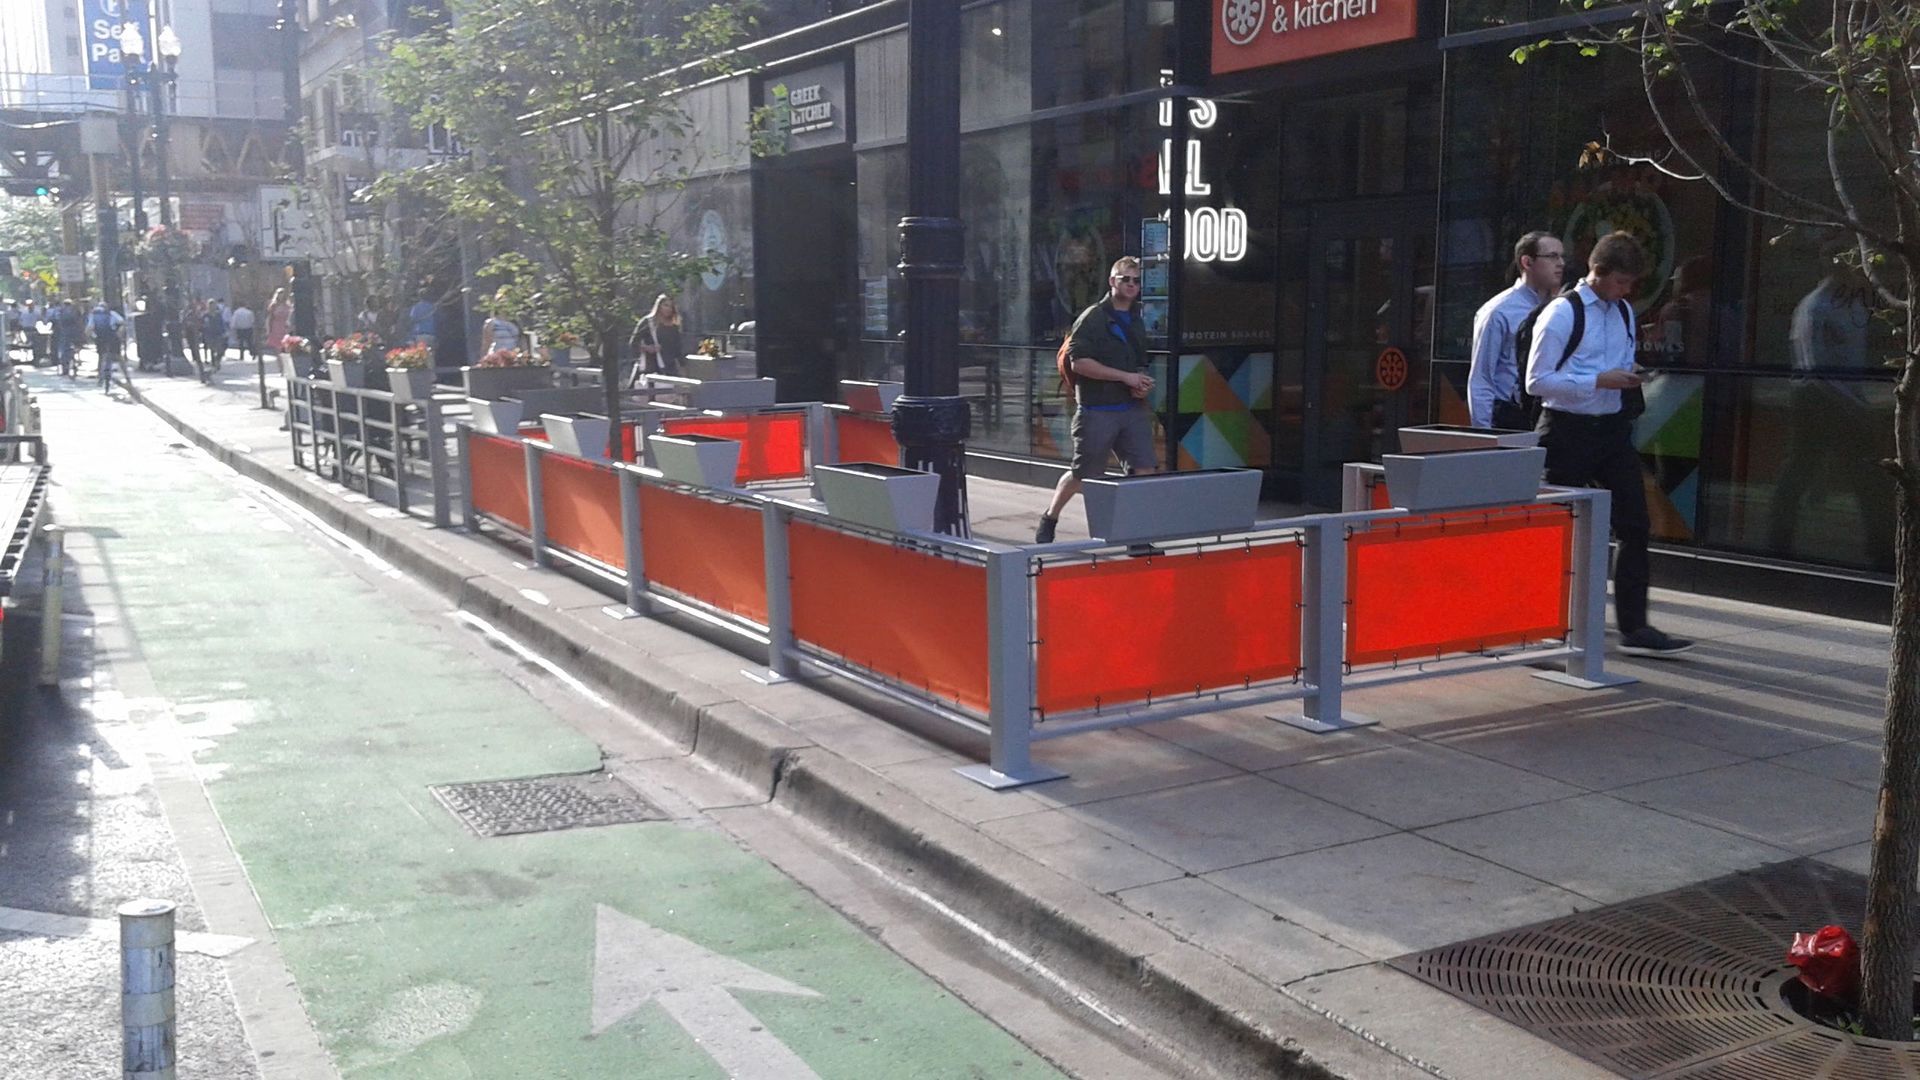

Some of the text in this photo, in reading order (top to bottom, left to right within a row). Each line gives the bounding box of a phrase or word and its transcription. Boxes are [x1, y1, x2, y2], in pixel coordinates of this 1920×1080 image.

[1272, 0, 1378, 34] & kitchen
[790, 84, 821, 106] GREEK
[1182, 330, 1227, 340] PROTEIN
